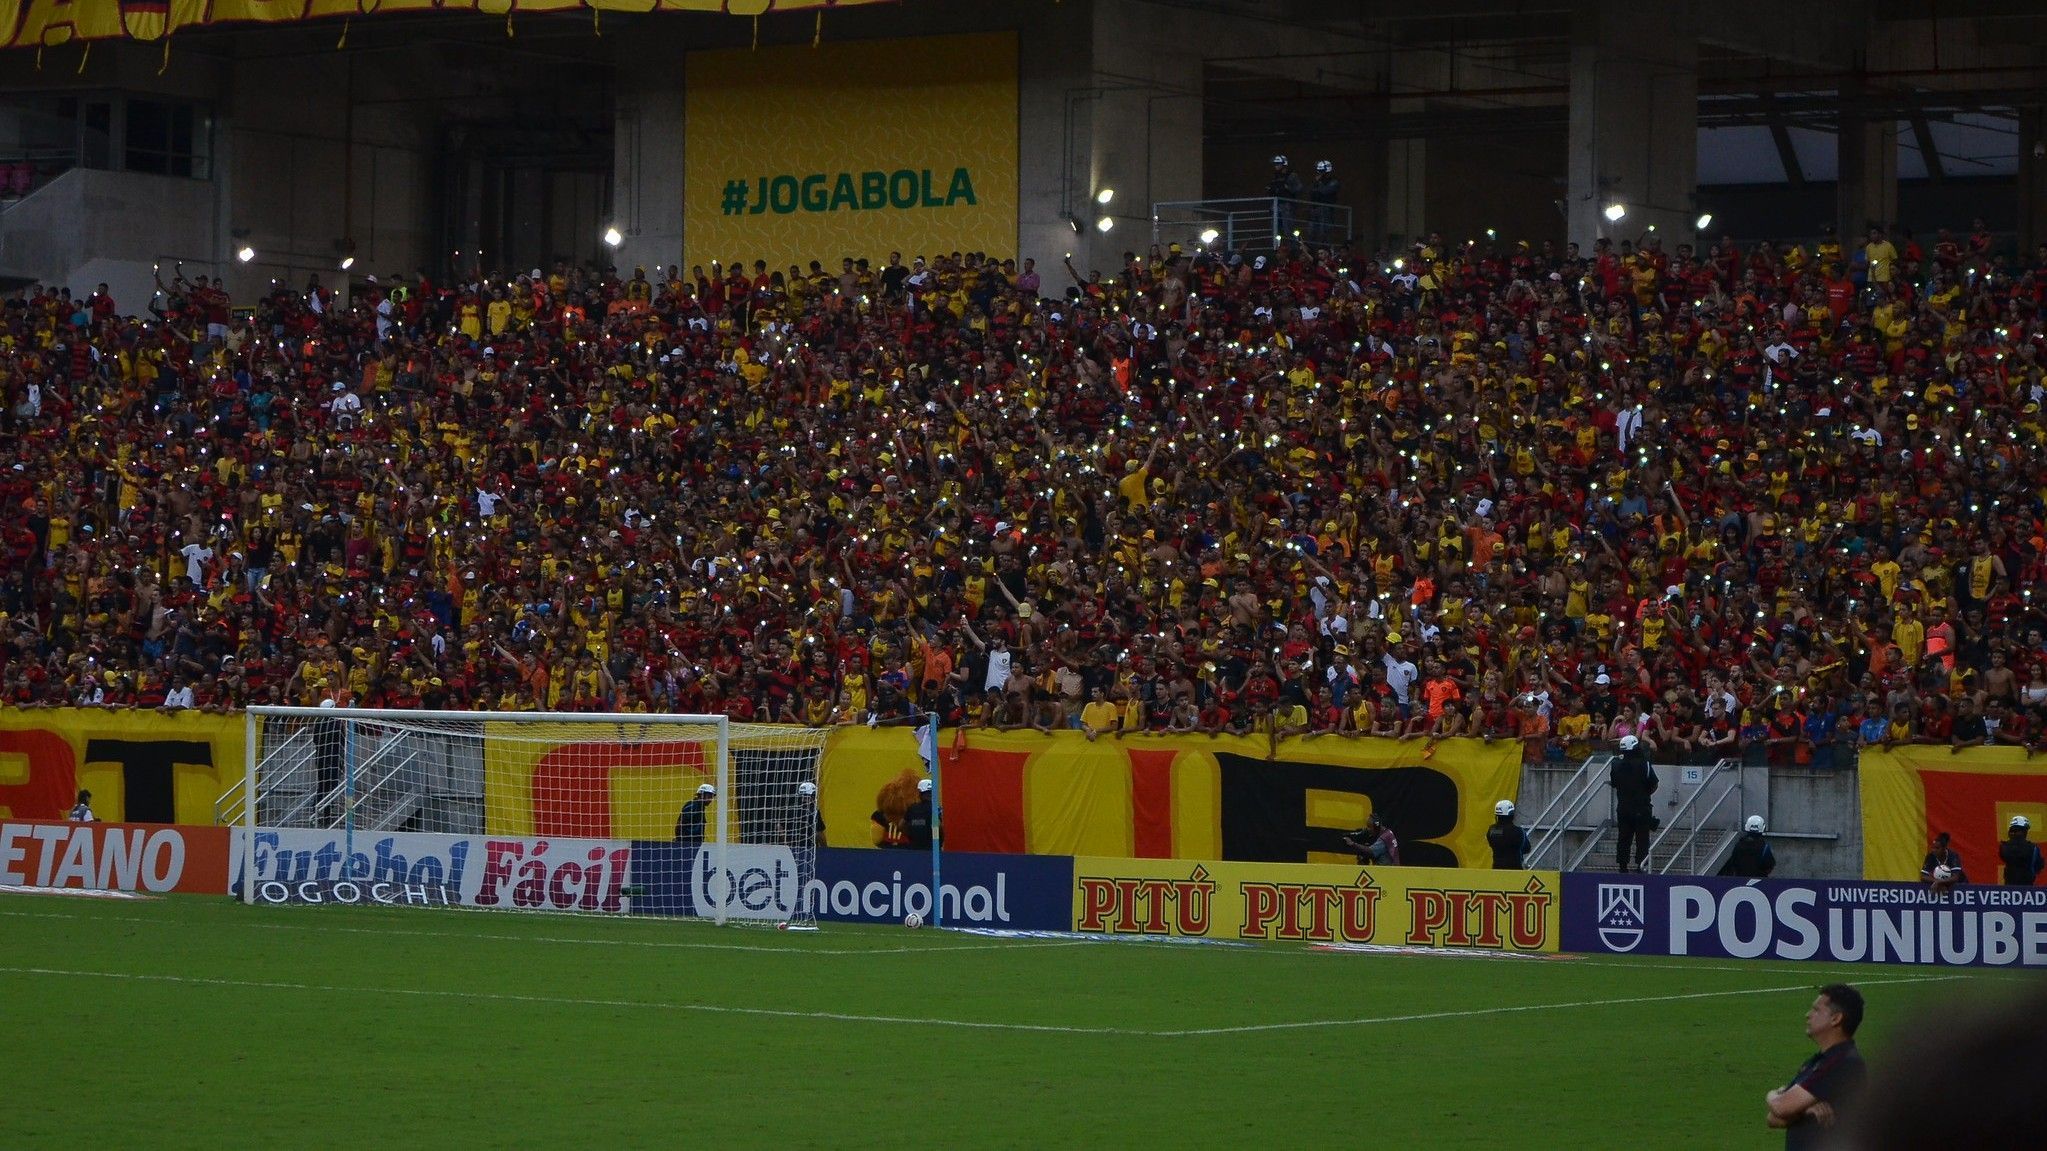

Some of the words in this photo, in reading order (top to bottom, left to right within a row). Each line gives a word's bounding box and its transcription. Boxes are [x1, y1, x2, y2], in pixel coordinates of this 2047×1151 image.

[720, 167, 977, 216] #JOGABOLA
[1687, 770, 1698, 779] 15
[0, 823, 186, 892] ETANO
[474, 840, 630, 912] Fácil
[261, 881, 449, 905] OGOCHI
[1078, 864, 1216, 936] PITÚ
[1239, 870, 1381, 943] PITÚ
[1406, 875, 1552, 950] PITÚ
[1669, 878, 1821, 960] PÓS
[1828, 887, 1949, 905] UNIVERSIDADE
[1953, 890, 1976, 905] DE
